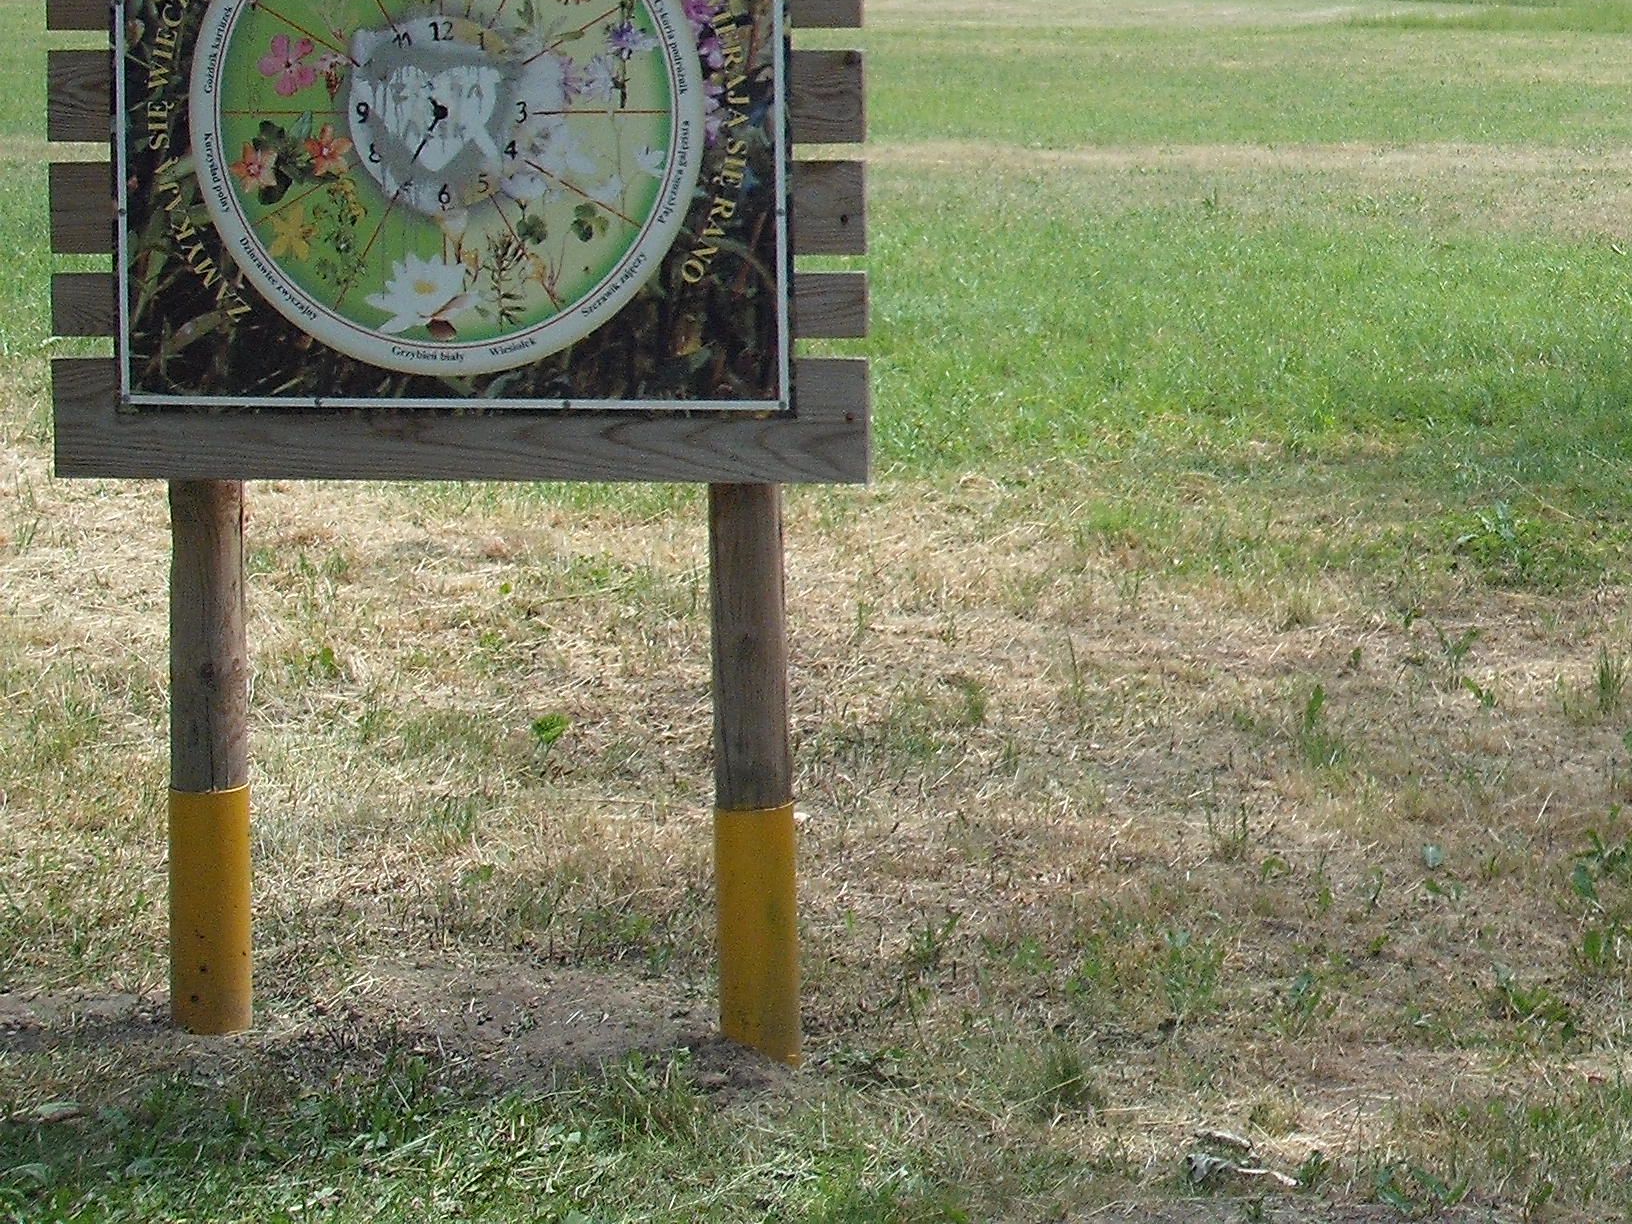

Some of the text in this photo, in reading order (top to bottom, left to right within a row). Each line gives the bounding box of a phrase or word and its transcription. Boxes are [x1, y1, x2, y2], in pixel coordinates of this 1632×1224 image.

[428, 21, 454, 41] 12
[356, 102, 370, 124] 9
[516, 102, 529, 123] 3
[146, 98, 175, 151] SIĘ
[504, 140, 518, 160] 4
[712, 139, 749, 198] SIĘ
[438, 183, 450, 204] 6
[478, 174, 488, 193] 5
[680, 196, 737, 284] RANO
